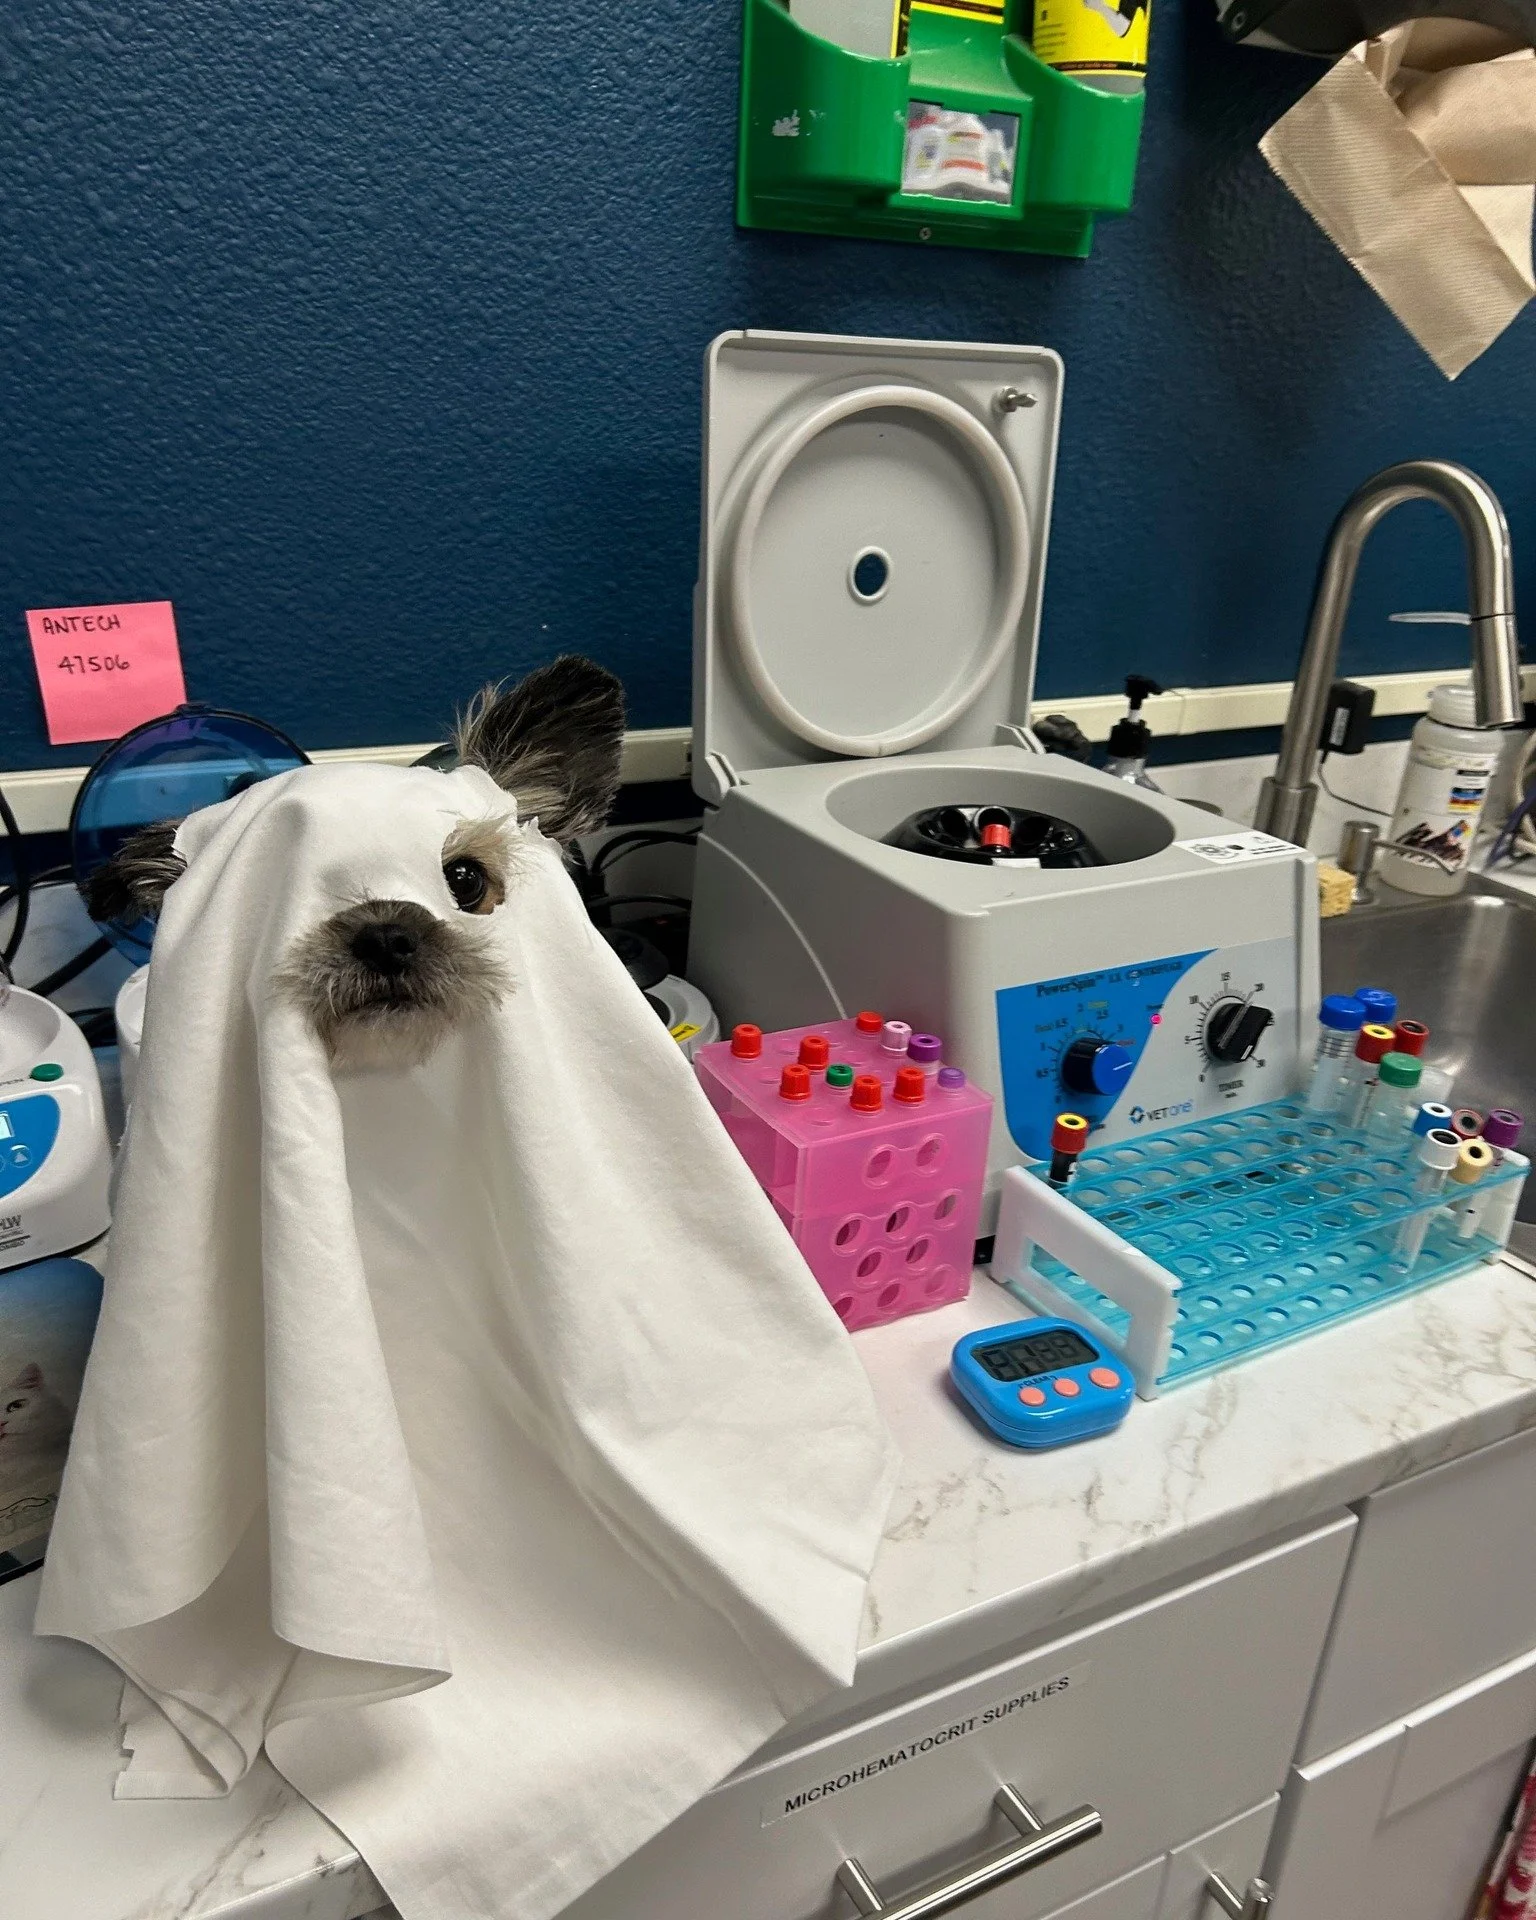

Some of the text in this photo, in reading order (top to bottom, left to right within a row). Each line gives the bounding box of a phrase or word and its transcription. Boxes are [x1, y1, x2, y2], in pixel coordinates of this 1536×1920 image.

[42, 614, 121, 635] ANTECH
[57, 654, 131, 675] 47506
[784, 1675, 1071, 1814] MICROHEMATOCRIT SUPPLIES
